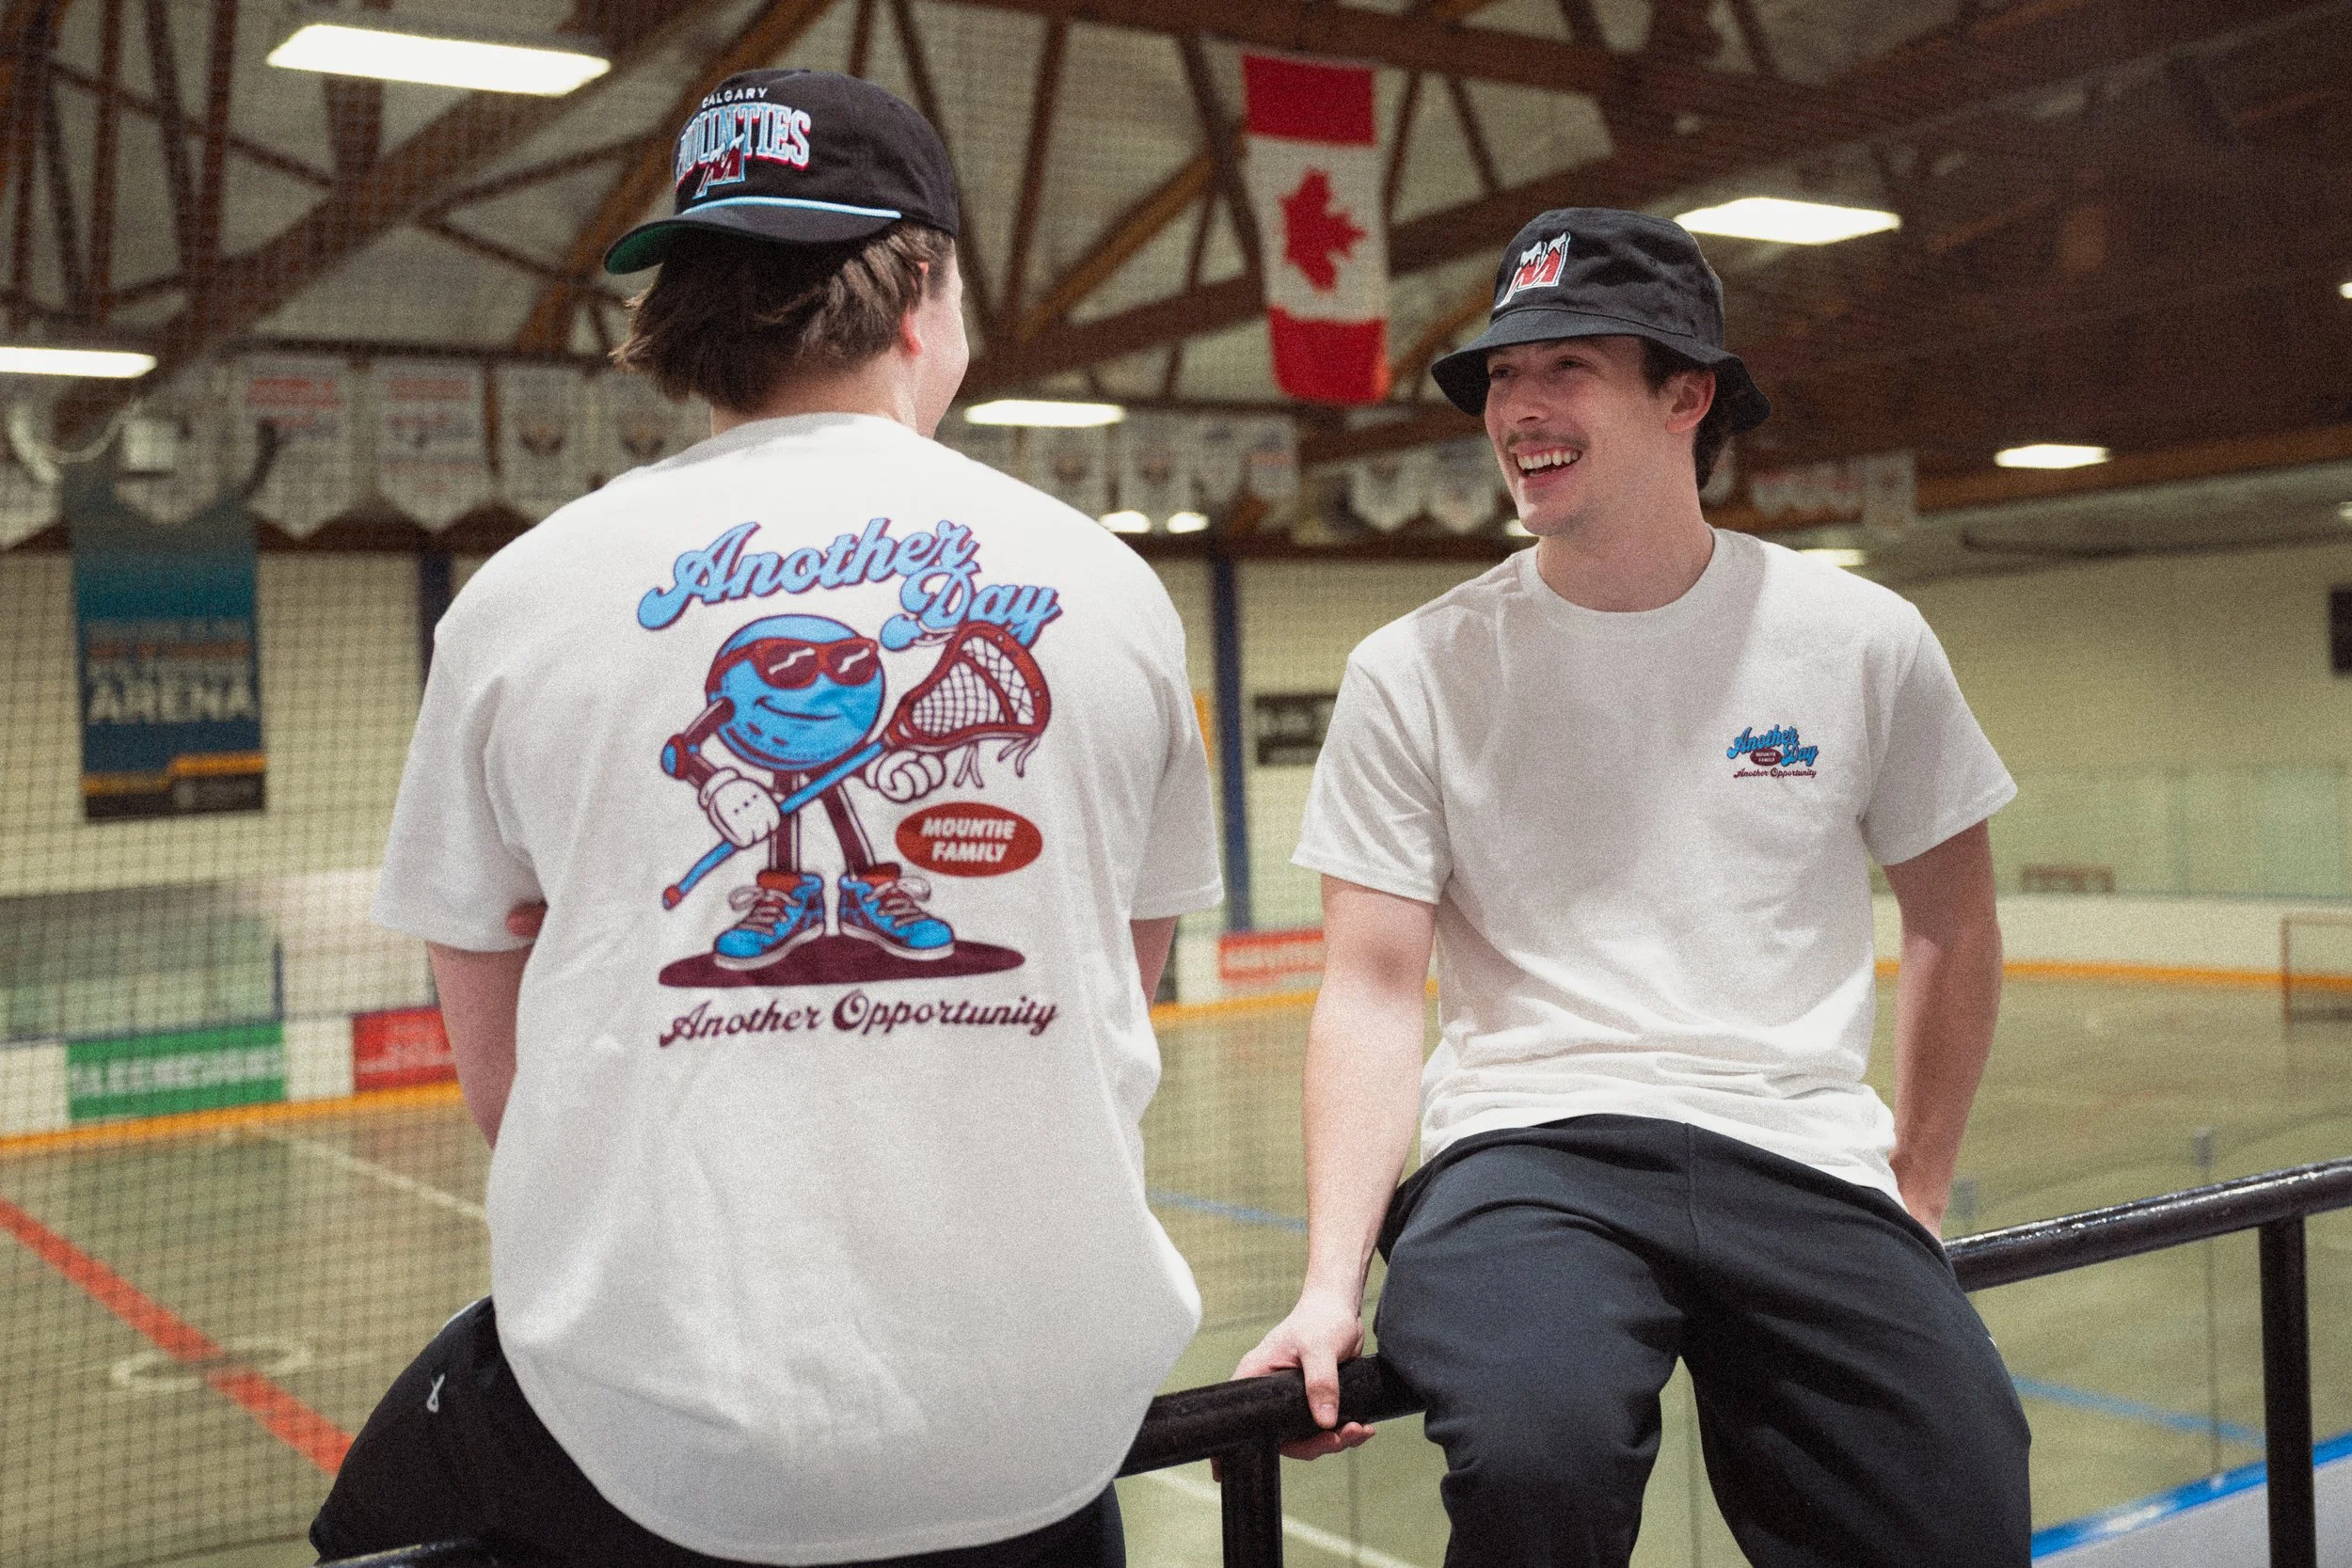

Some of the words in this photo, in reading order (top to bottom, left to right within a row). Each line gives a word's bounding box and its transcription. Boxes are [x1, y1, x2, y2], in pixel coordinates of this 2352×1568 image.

[702, 87, 768, 108] CALGARY
[638, 517, 981, 630] Another
[880, 564, 1063, 652] Day
[1726, 724, 1800, 759] Another
[1781, 743, 1819, 767] Day
[1733, 768, 1769, 779] Another
[1770, 768, 1817, 779] Opportunity
[920, 816, 1017, 840] MOUNTIE
[930, 840, 1008, 863] FAMILY
[660, 999, 824, 1047] Another
[833, 989, 1059, 1036] Opportunity
